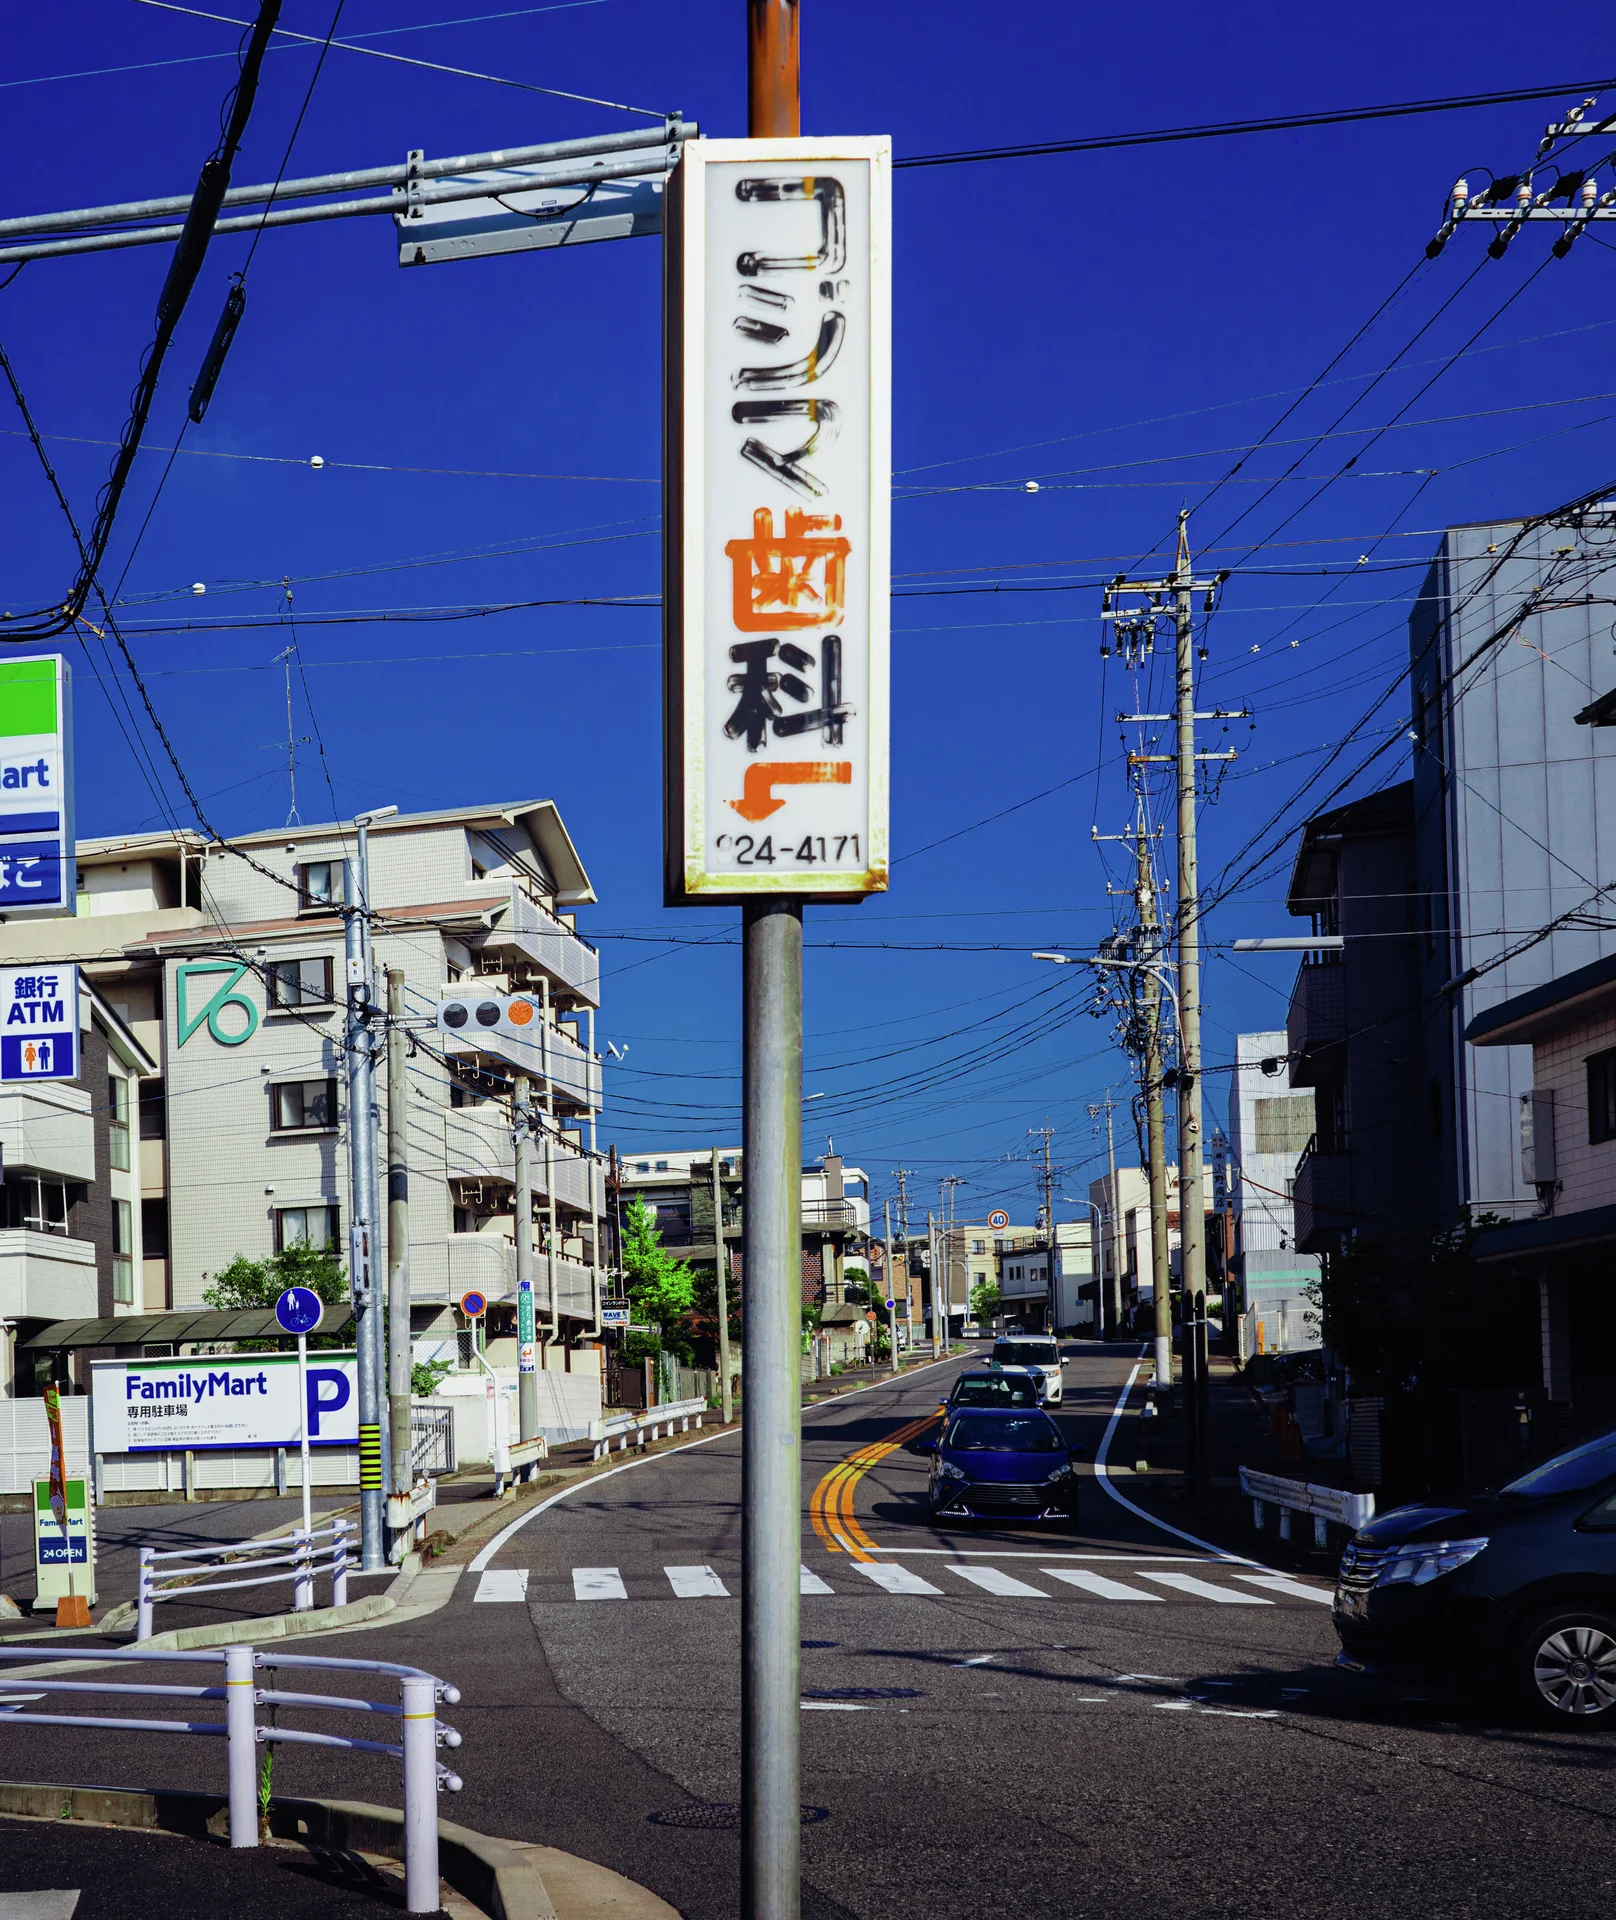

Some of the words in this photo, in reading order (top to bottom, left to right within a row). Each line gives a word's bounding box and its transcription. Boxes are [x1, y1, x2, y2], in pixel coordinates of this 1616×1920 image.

[0, 759, 49, 789] art
[14, 975, 59, 999] 銀行
[7, 1000, 64, 1025] ATM
[993, 1215, 1004, 1224] 40
[126, 1372, 267, 1403] FamilyMart
[127, 1404, 188, 1418] 専用駐車場
[306, 1369, 350, 1436] P
[39, 1518, 83, 1526] Famart
[43, 1549, 55, 1558] 24
[55, 1548, 82, 1558] OPEN
